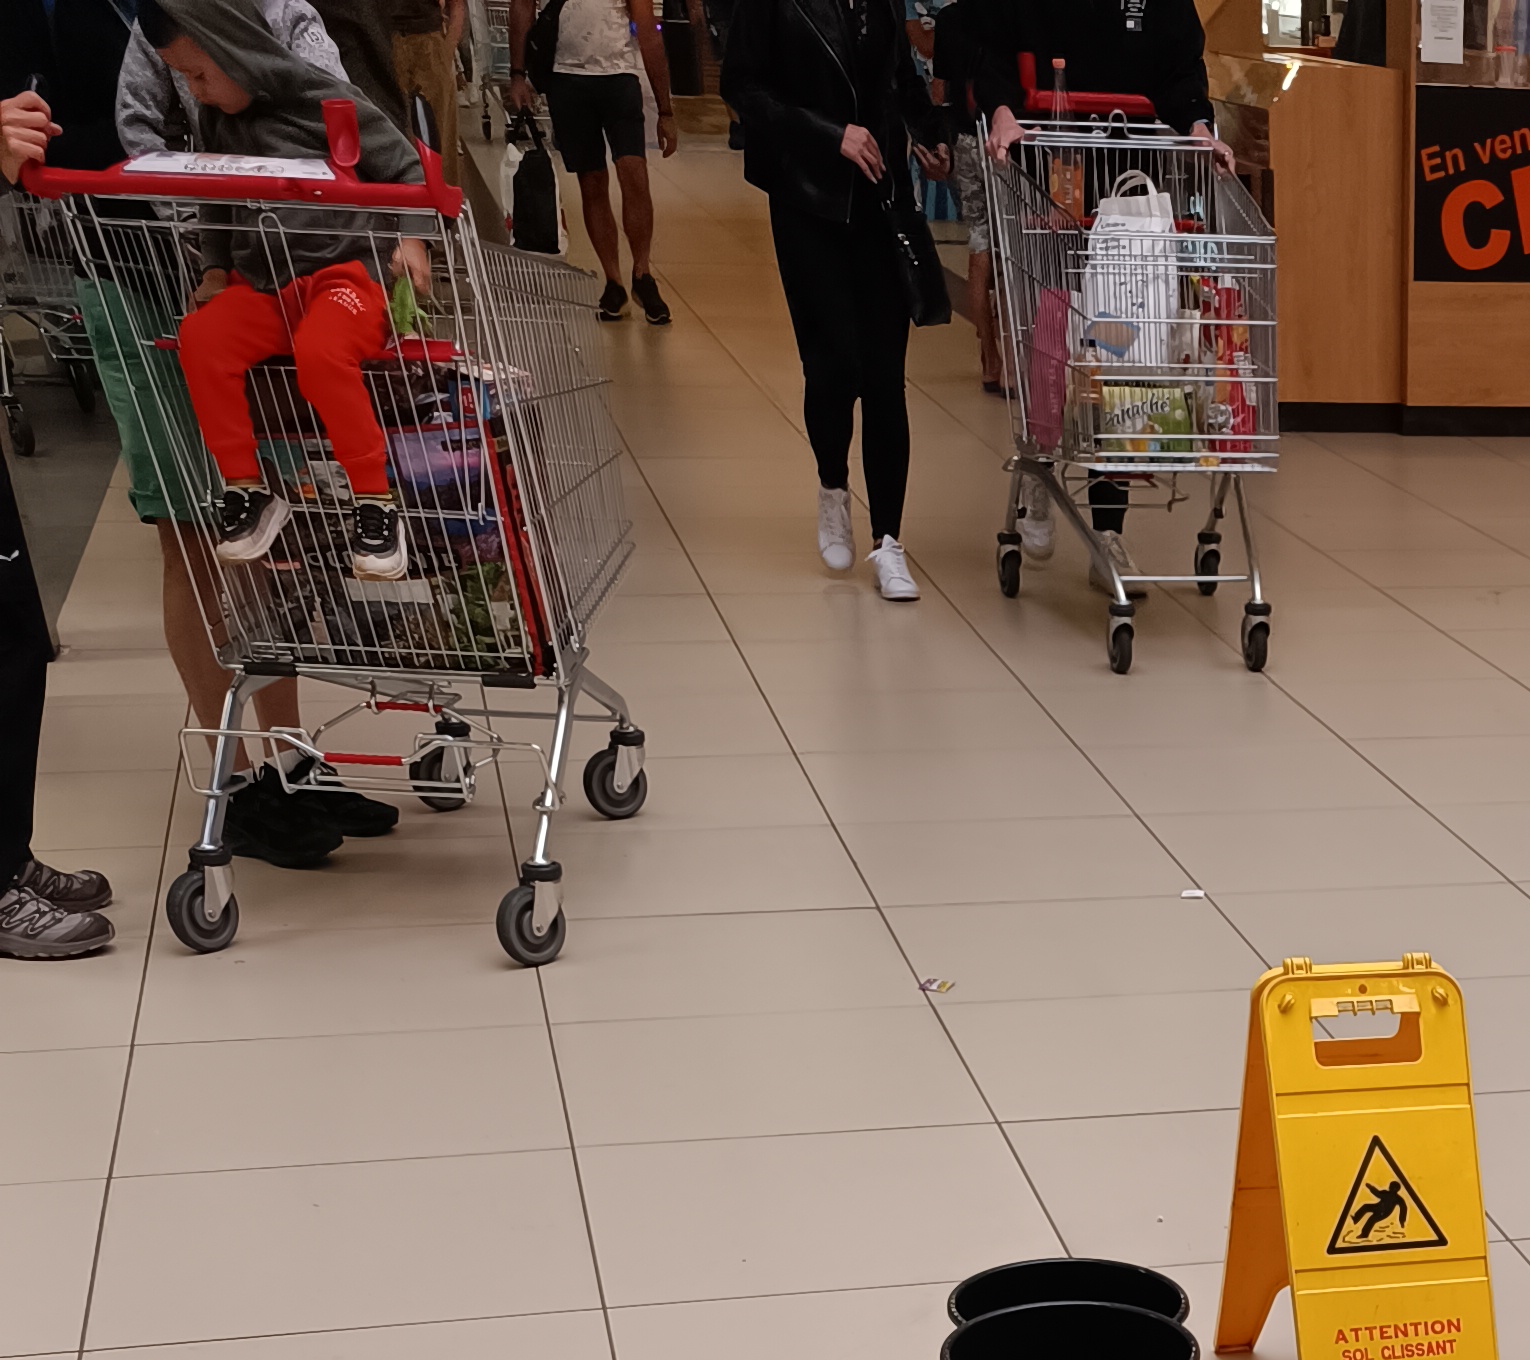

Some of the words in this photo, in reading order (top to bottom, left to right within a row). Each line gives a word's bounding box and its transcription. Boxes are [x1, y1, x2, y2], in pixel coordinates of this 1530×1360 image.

[1421, 145, 1466, 182] En
[1335, 1318, 1461, 1344] ATTENTION
[1381, 1339, 1456, 1360] GLISSANT
